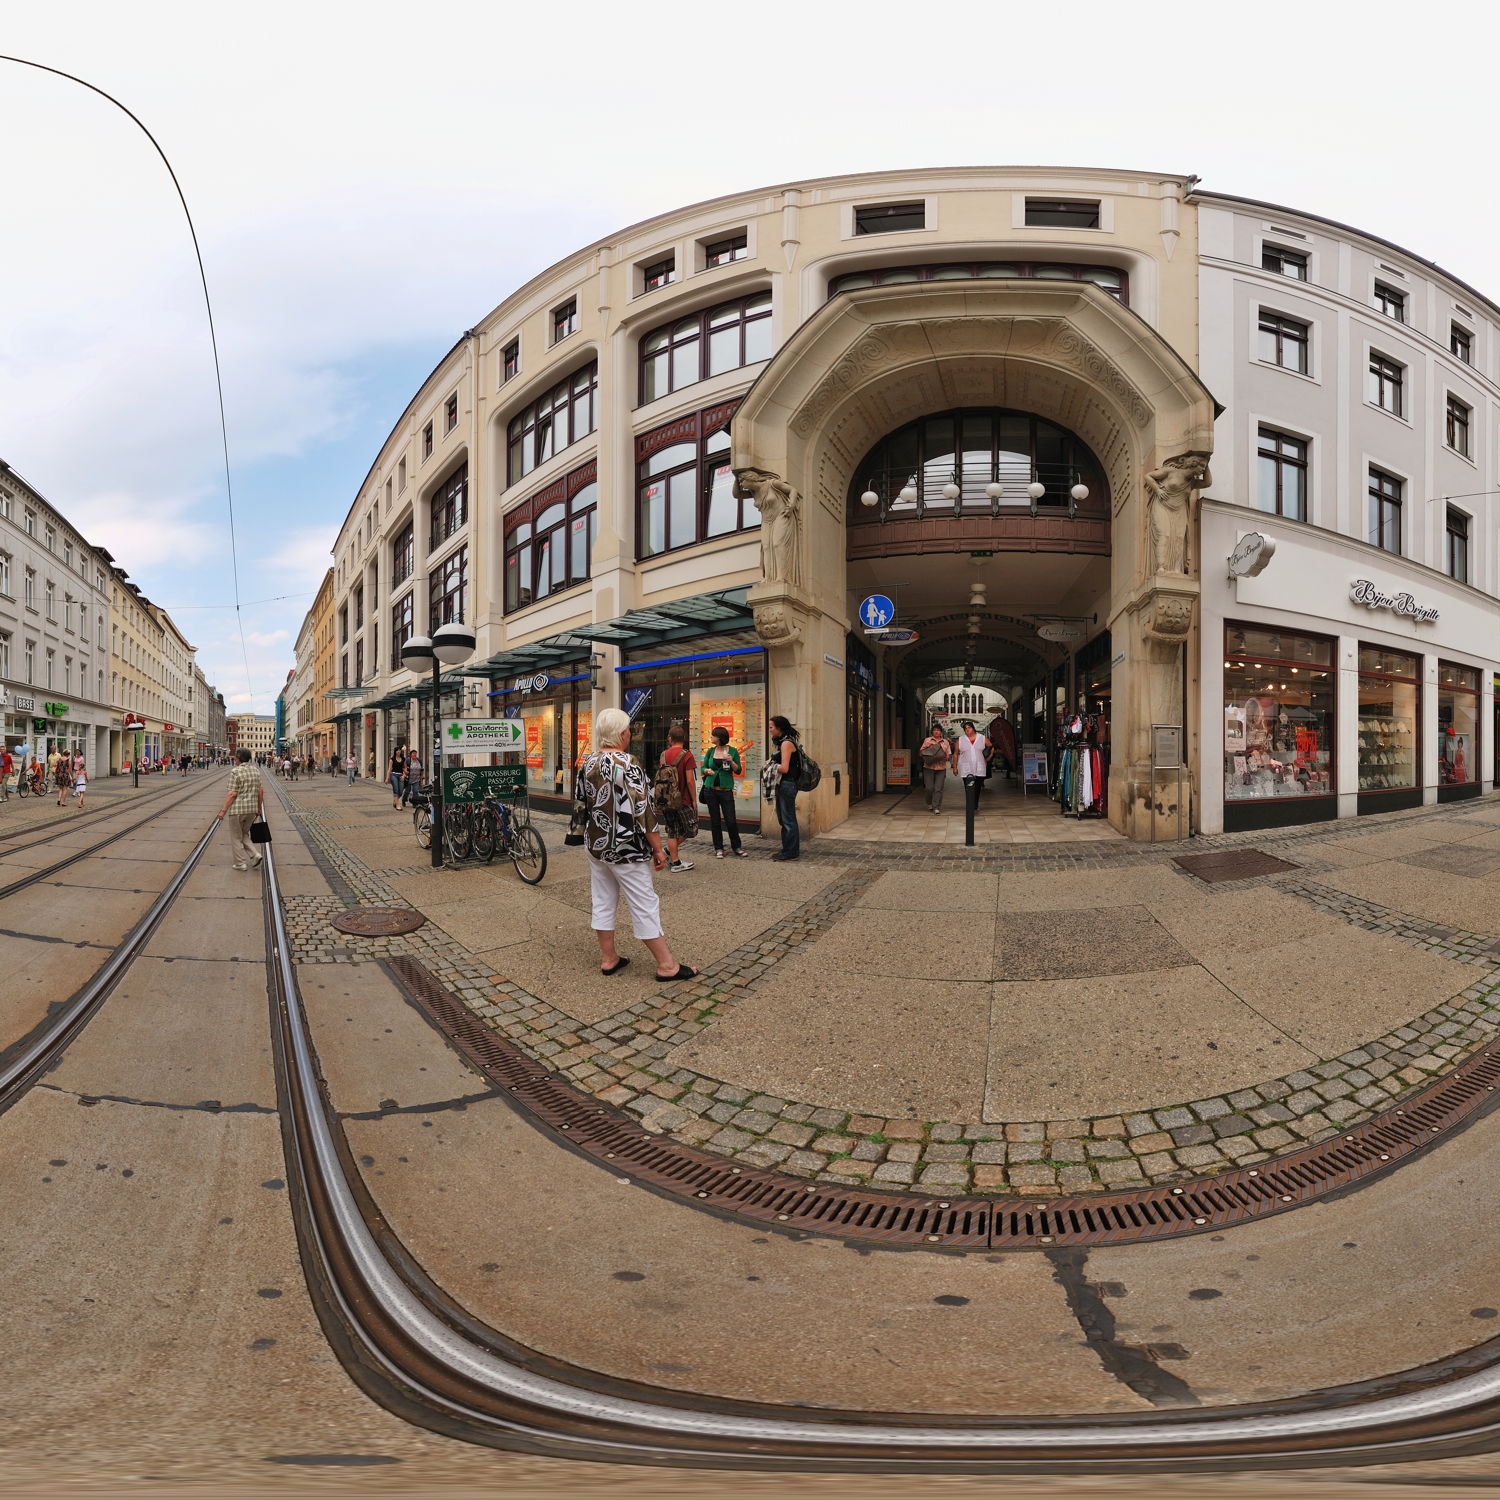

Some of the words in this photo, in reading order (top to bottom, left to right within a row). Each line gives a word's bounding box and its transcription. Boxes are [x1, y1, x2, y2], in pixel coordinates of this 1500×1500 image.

[1355, 579, 1394, 607] Bijou
[1397, 592, 1440, 621] Brigitte
[18, 698, 33, 710] BASE
[480, 769, 521, 778] STRASSBURG
[487, 776, 515, 785] PASSAGE
